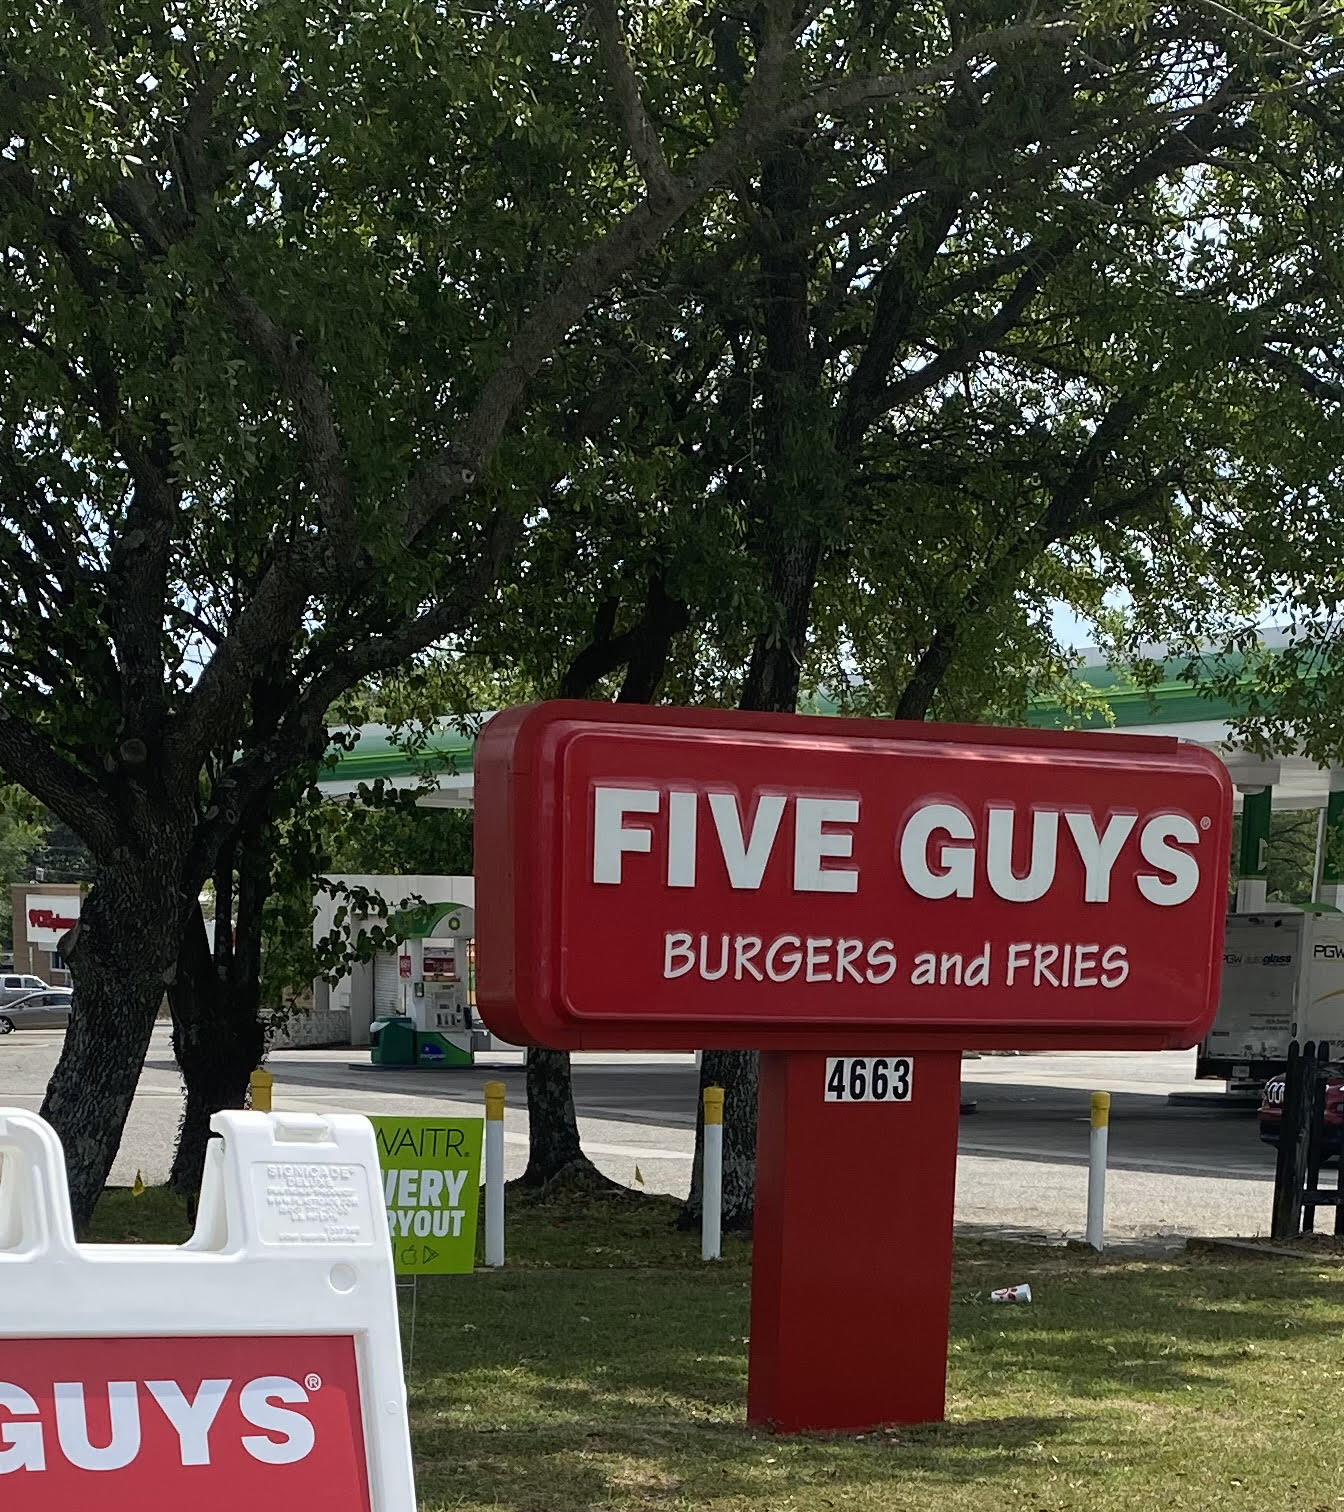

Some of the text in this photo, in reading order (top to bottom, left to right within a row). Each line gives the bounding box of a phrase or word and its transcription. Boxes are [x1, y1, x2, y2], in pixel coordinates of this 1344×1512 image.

[592, 786, 860, 893] FIVE
[663, 931, 1130, 989] BURGERS and FRIES
[827, 1059, 910, 1102] 4663
